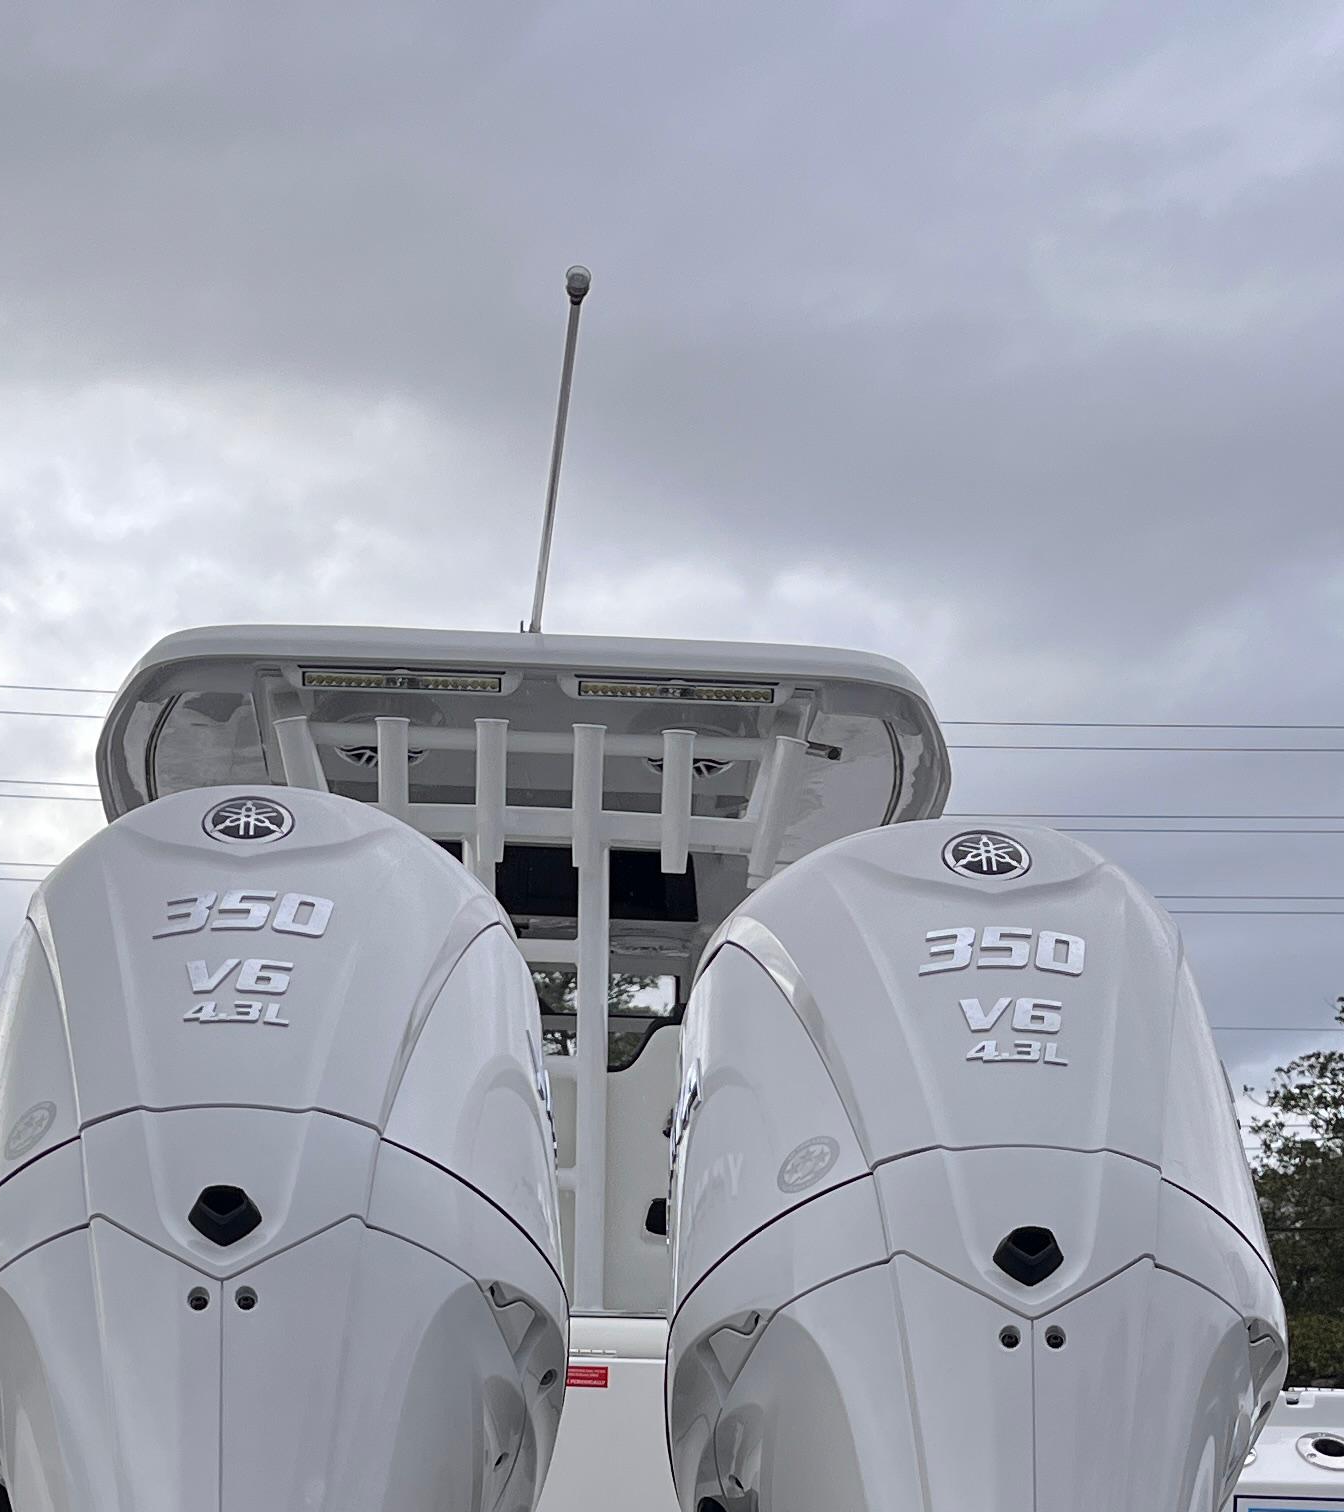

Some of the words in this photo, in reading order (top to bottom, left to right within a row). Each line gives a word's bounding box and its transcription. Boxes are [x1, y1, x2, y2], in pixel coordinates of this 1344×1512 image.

[152, 889, 336, 939] 350
[918, 926, 1086, 977] 350
[185, 958, 294, 995] V6
[183, 1000, 289, 1027] 4.3L
[958, 997, 1063, 1034] V6
[966, 1039, 1068, 1067] 4.3L
